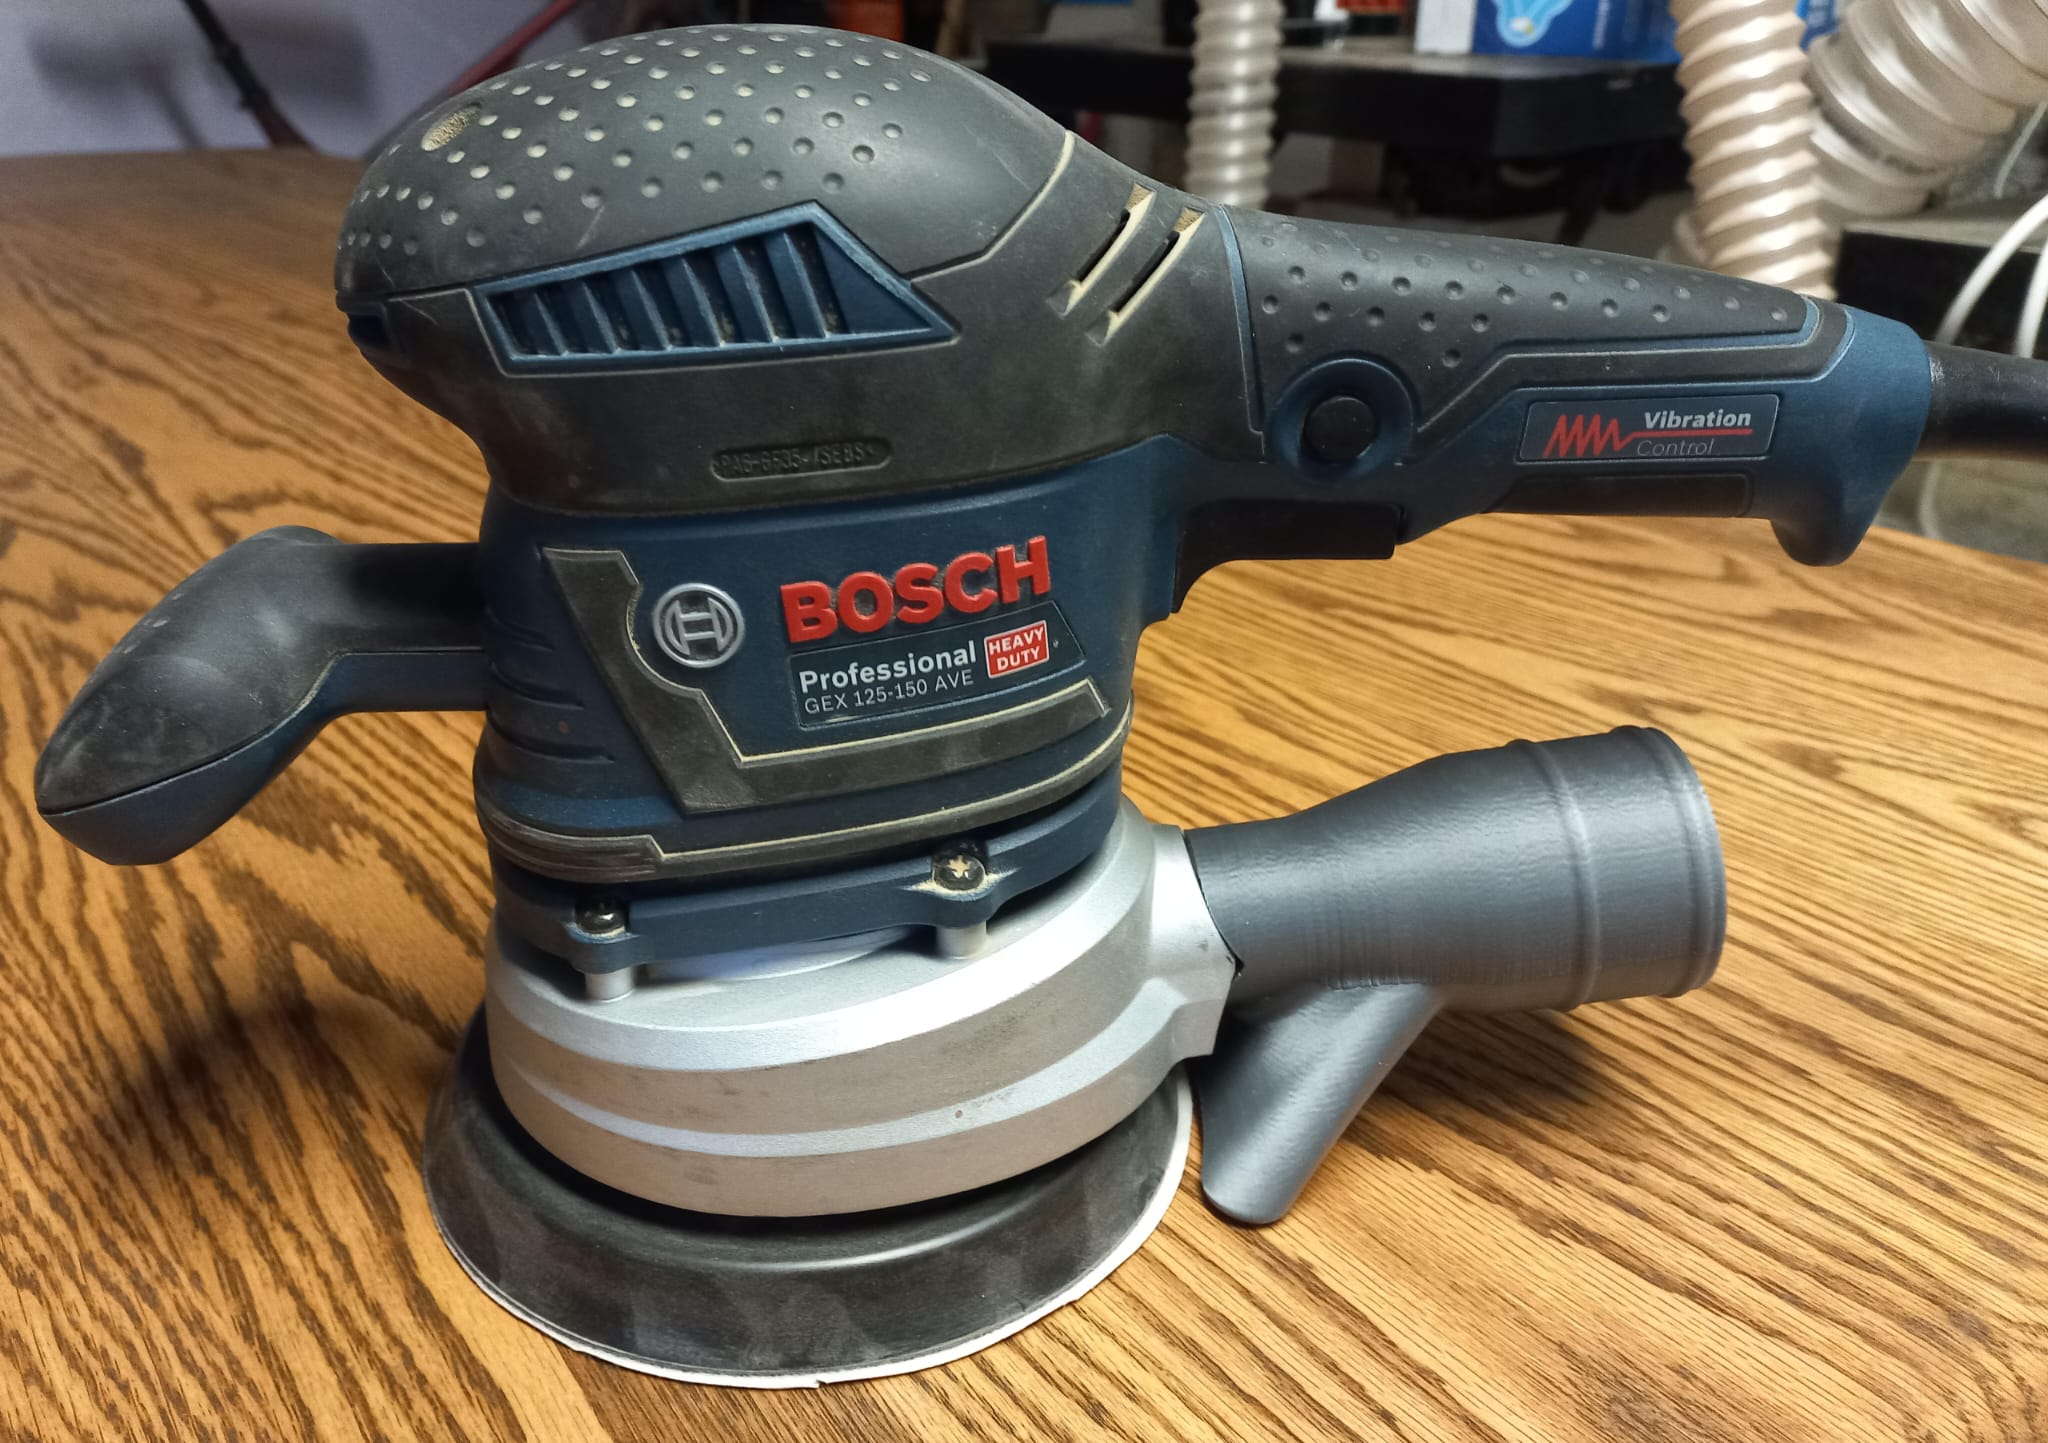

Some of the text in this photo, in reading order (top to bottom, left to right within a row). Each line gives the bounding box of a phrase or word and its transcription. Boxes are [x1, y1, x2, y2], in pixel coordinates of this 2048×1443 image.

[1644, 408, 1752, 430] Vibration
[1637, 437, 1716, 457] Control
[779, 535, 1052, 643] BOSCH
[989, 626, 1046, 657] HEAVY
[799, 639, 978, 694] Professional
[997, 645, 1041, 671] DUTY
[804, 669, 975, 715] GEX 125-150 AVE
